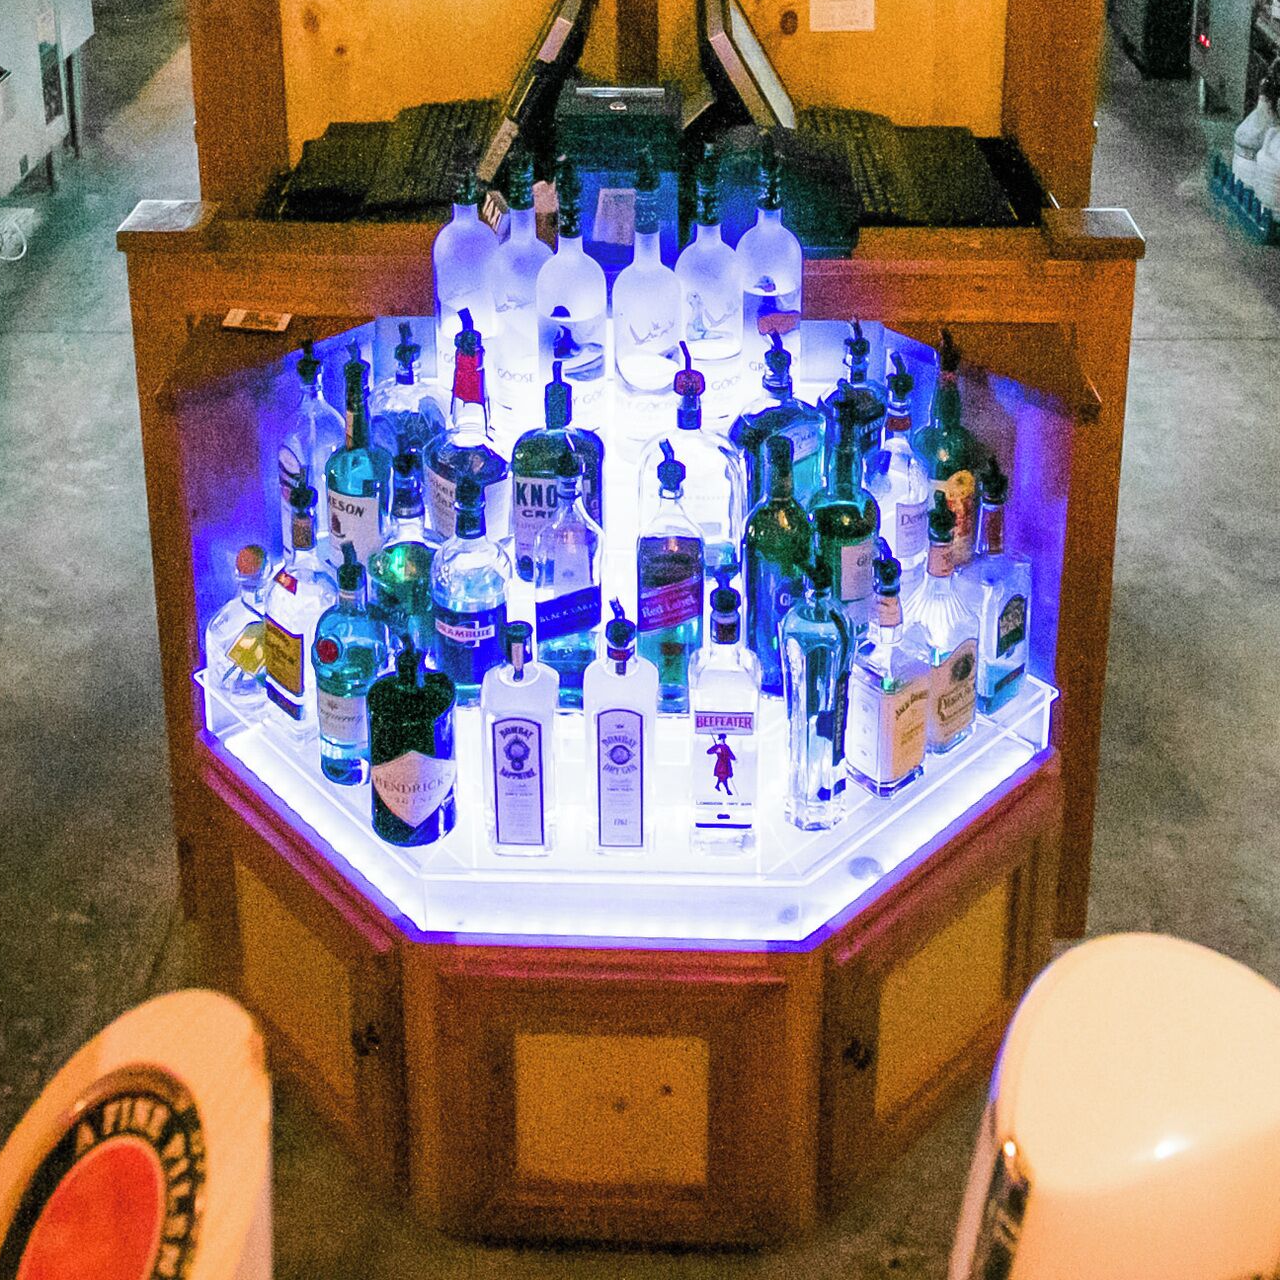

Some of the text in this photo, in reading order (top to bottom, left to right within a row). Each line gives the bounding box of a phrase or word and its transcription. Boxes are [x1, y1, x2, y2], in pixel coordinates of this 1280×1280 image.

[516, 482, 558, 508] KNO
[329, 499, 365, 518] ESON
[696, 715, 752, 730] BEEFEATER
[499, 725, 534, 740] BOMBAY
[602, 735, 637, 749] BOMBAY
